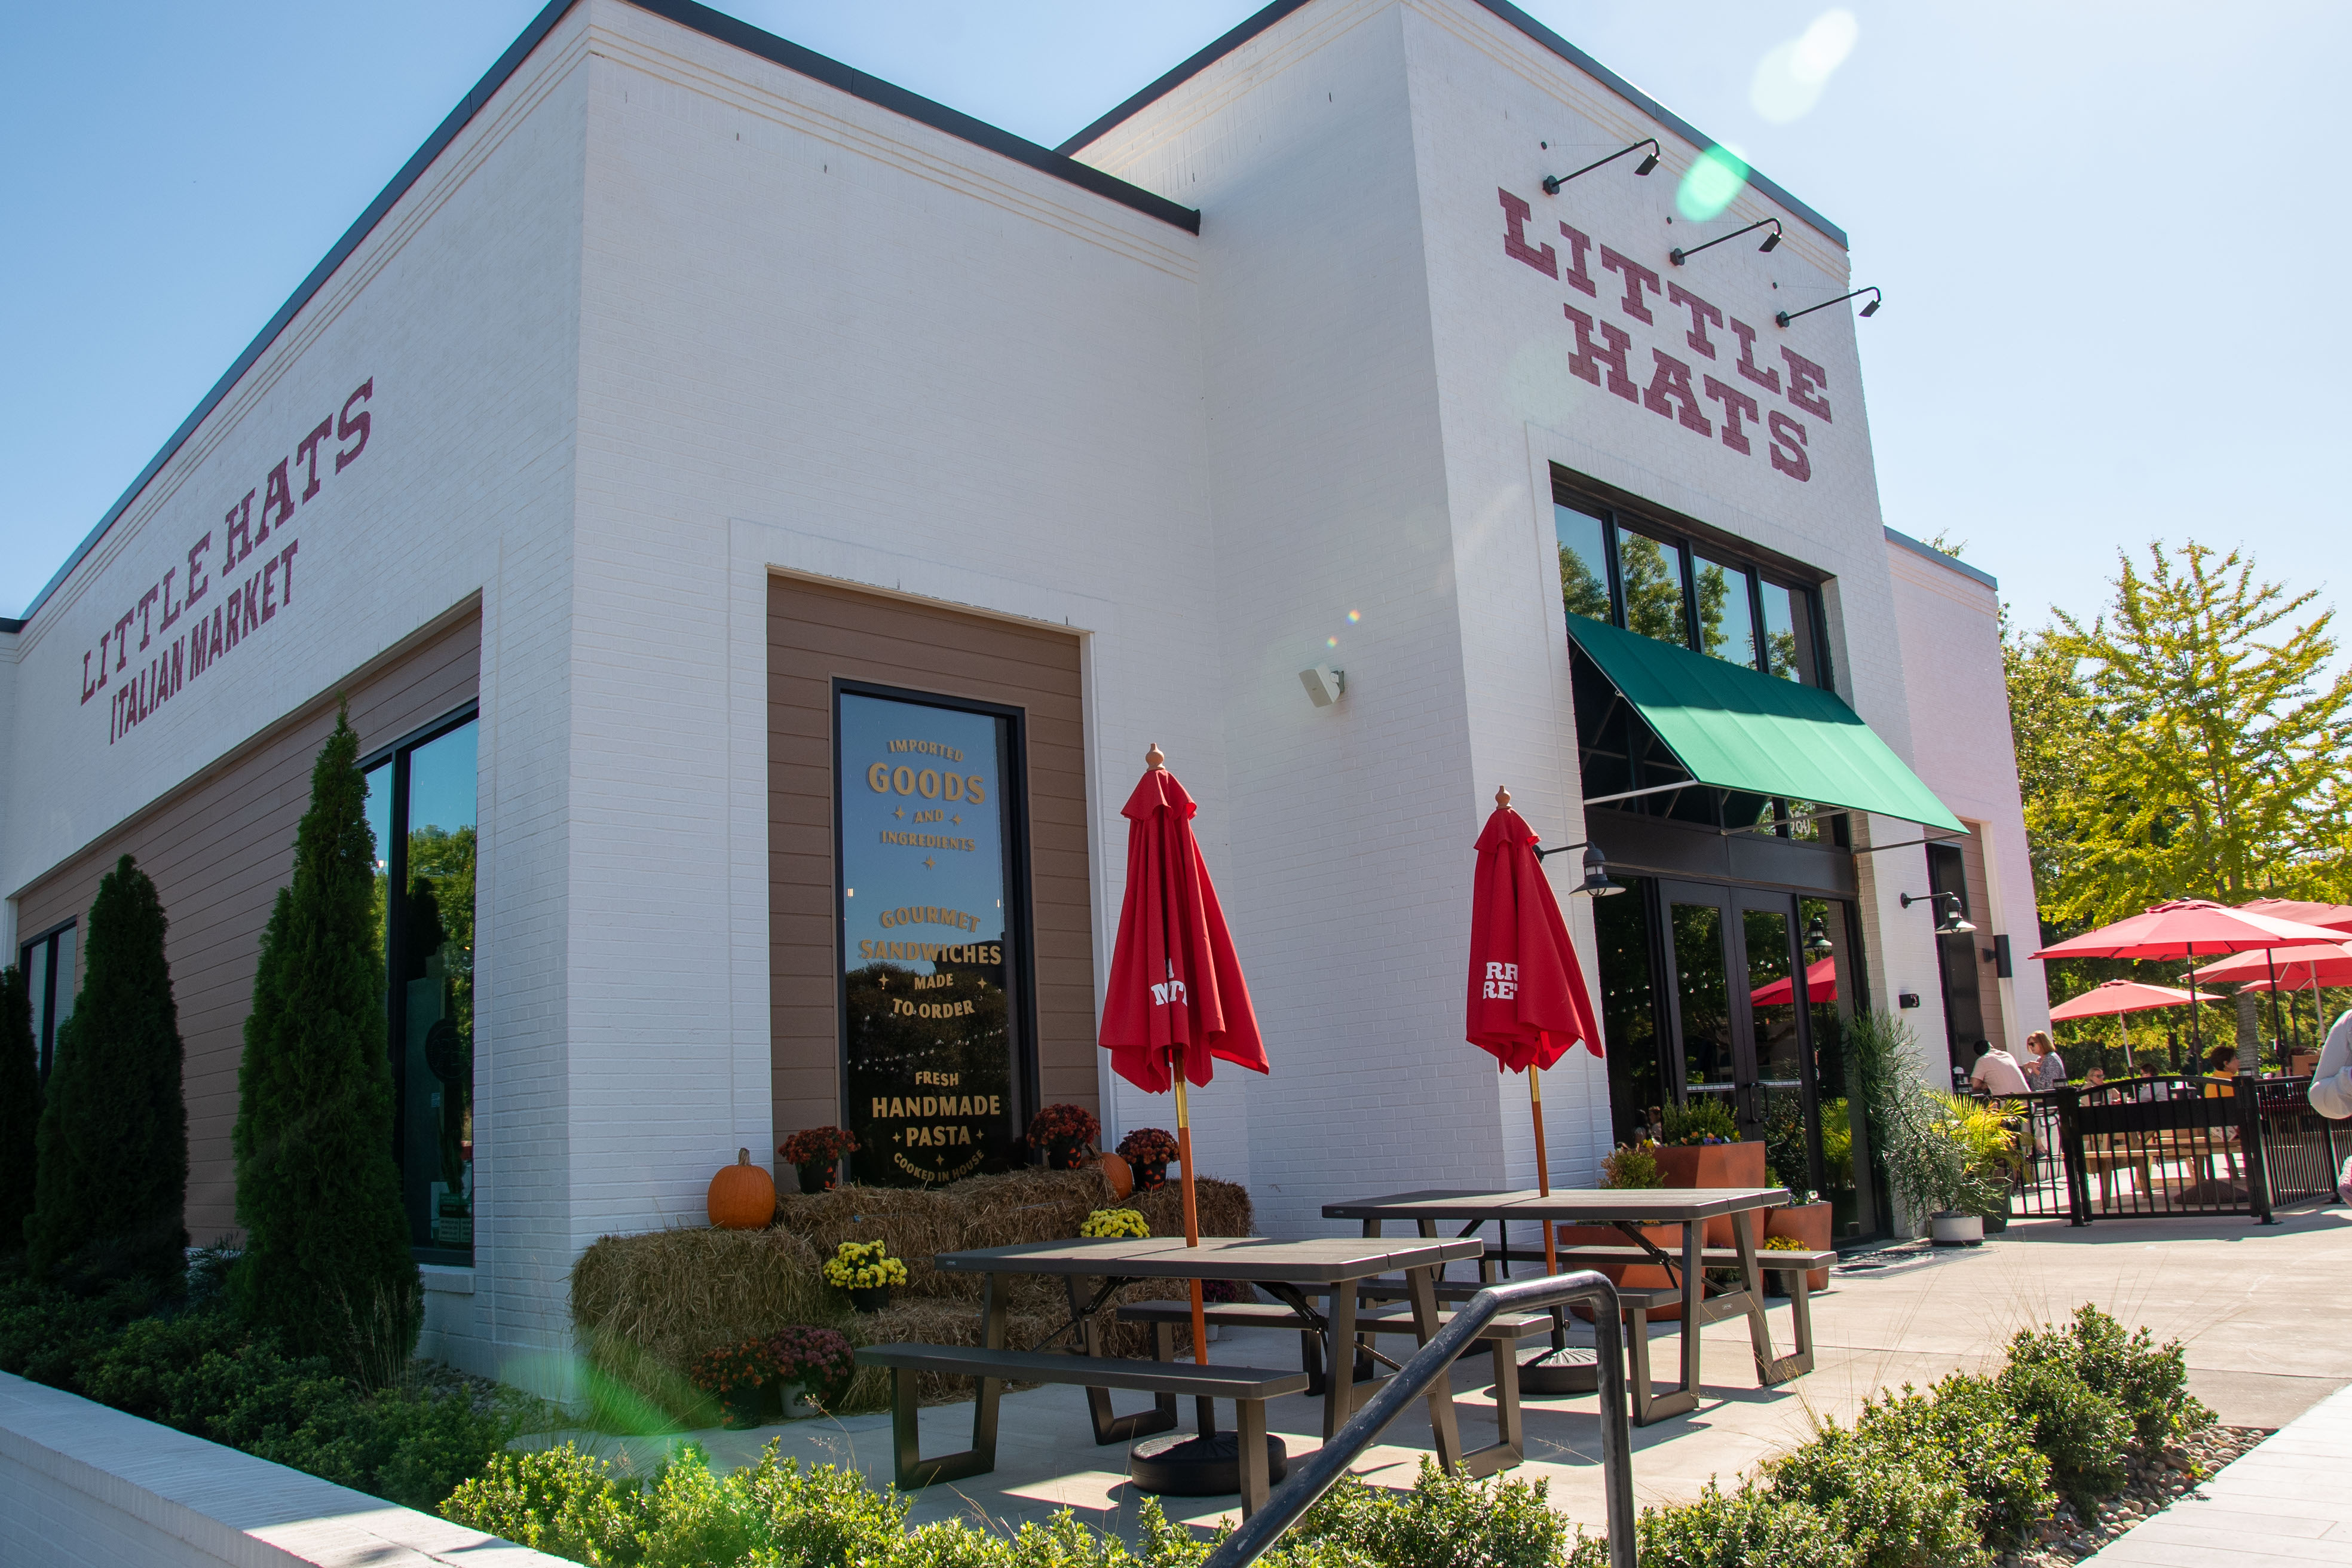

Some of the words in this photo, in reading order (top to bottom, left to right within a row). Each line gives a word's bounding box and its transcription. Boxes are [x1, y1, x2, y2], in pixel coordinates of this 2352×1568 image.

[1497, 186, 1833, 424] LITTLE
[1563, 302, 1811, 482] HATS
[81, 530, 212, 706] LITTLE
[222, 376, 373, 578] HATS
[110, 635, 185, 746] ITALIAN
[189, 538, 299, 682] MARKET
[888, 739, 964, 762] IMPORTED
[868, 762, 985, 804] GOODS
[914, 808, 944, 823] AND
[881, 830, 976, 852] INGREDIENTS
[881, 906, 981, 933] GOURMET
[860, 939, 1002, 964] SANDWICHES
[914, 973, 954, 990] MADE
[893, 998, 914, 1016] TO
[918, 1000, 975, 1019] ORDER
[915, 1071, 959, 1086] FRESH
[872, 1095, 1001, 1118] HANDMADE
[906, 1126, 972, 1147] PASTA
[894, 1153, 935, 1182] COOKED
[938, 1170, 950, 1183] IN
[953, 1149, 985, 1180] HOUSE
